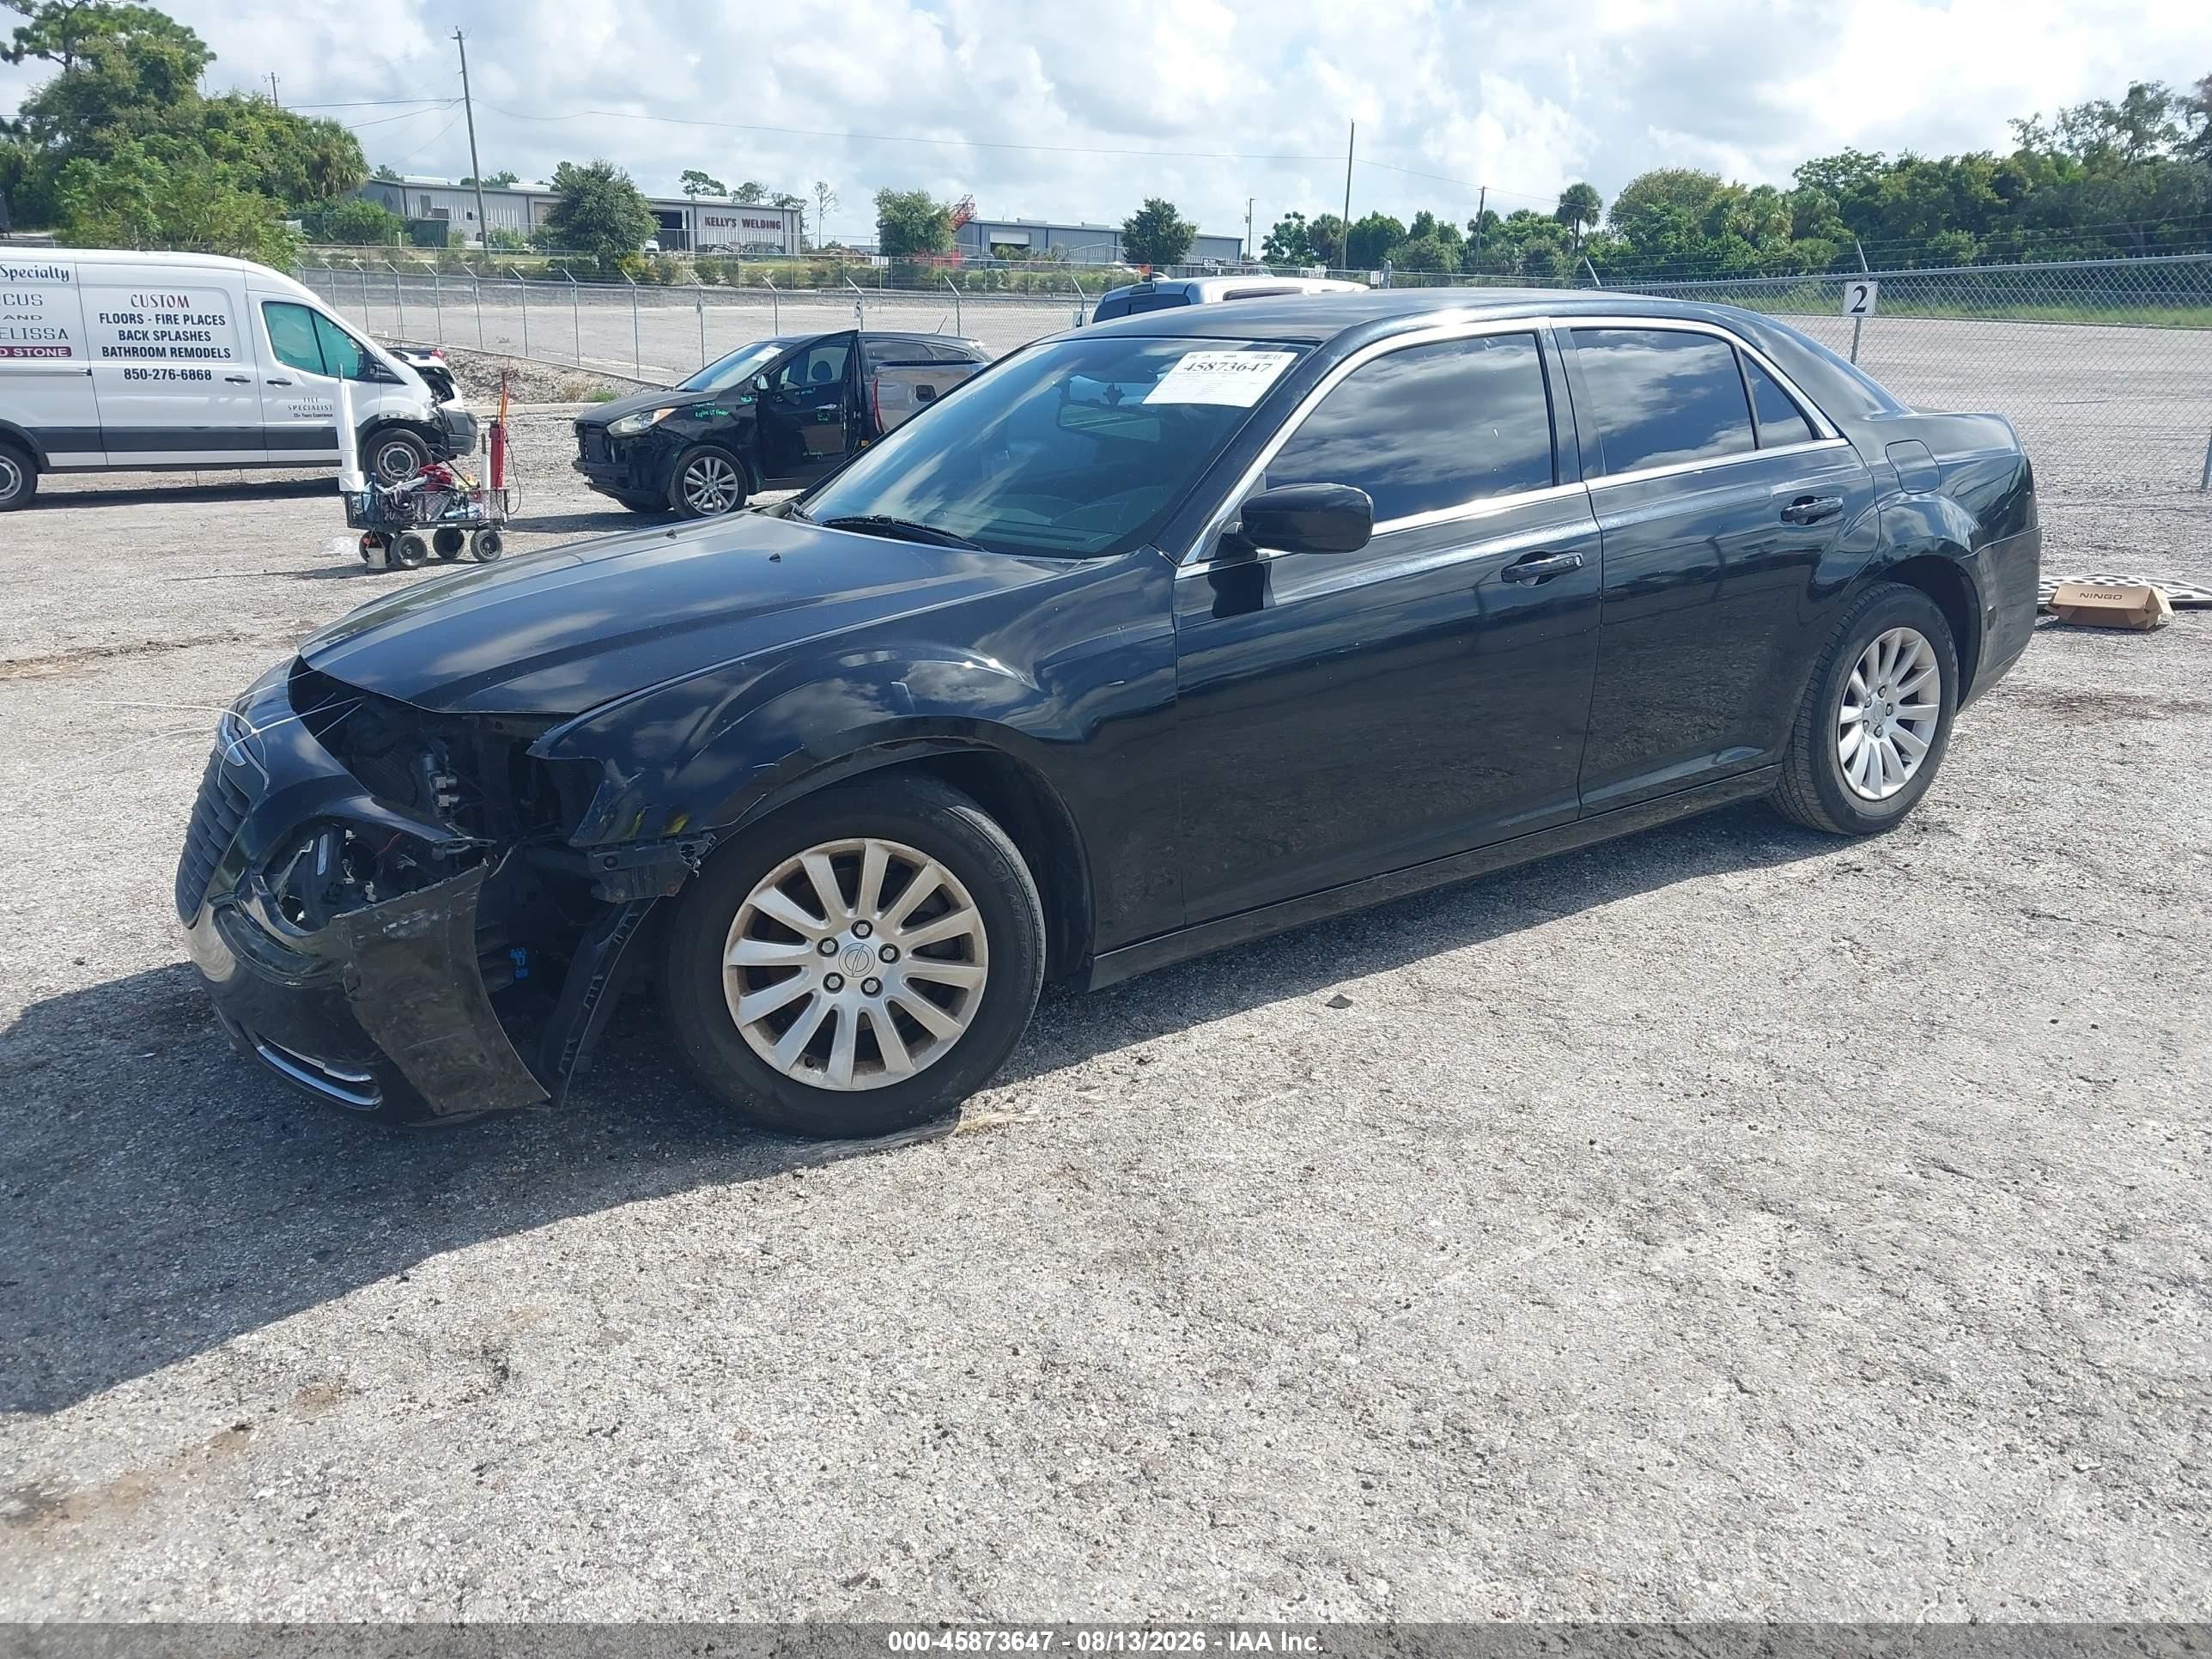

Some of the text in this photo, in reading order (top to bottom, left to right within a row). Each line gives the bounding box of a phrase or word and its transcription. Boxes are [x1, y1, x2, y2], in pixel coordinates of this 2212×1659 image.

[704, 216, 781, 230] KELLY'S WELDING
[0, 264, 69, 283] Specialty
[0, 294, 43, 306] CUS
[131, 294, 190, 308] CUSTOM
[1850, 285, 1868, 313] 2
[99, 313, 144, 325] FLOORS
[155, 313, 180, 325] FIRE
[183, 314, 226, 325] PLACES
[118, 330, 211, 342] BACK SPLASHES
[13, 348, 68, 357] STONE
[102, 346, 231, 358] BATHROOM REMODELS
[1183, 362, 1273, 373] 45873647
[124, 368, 212, 380] 850-276-6868
